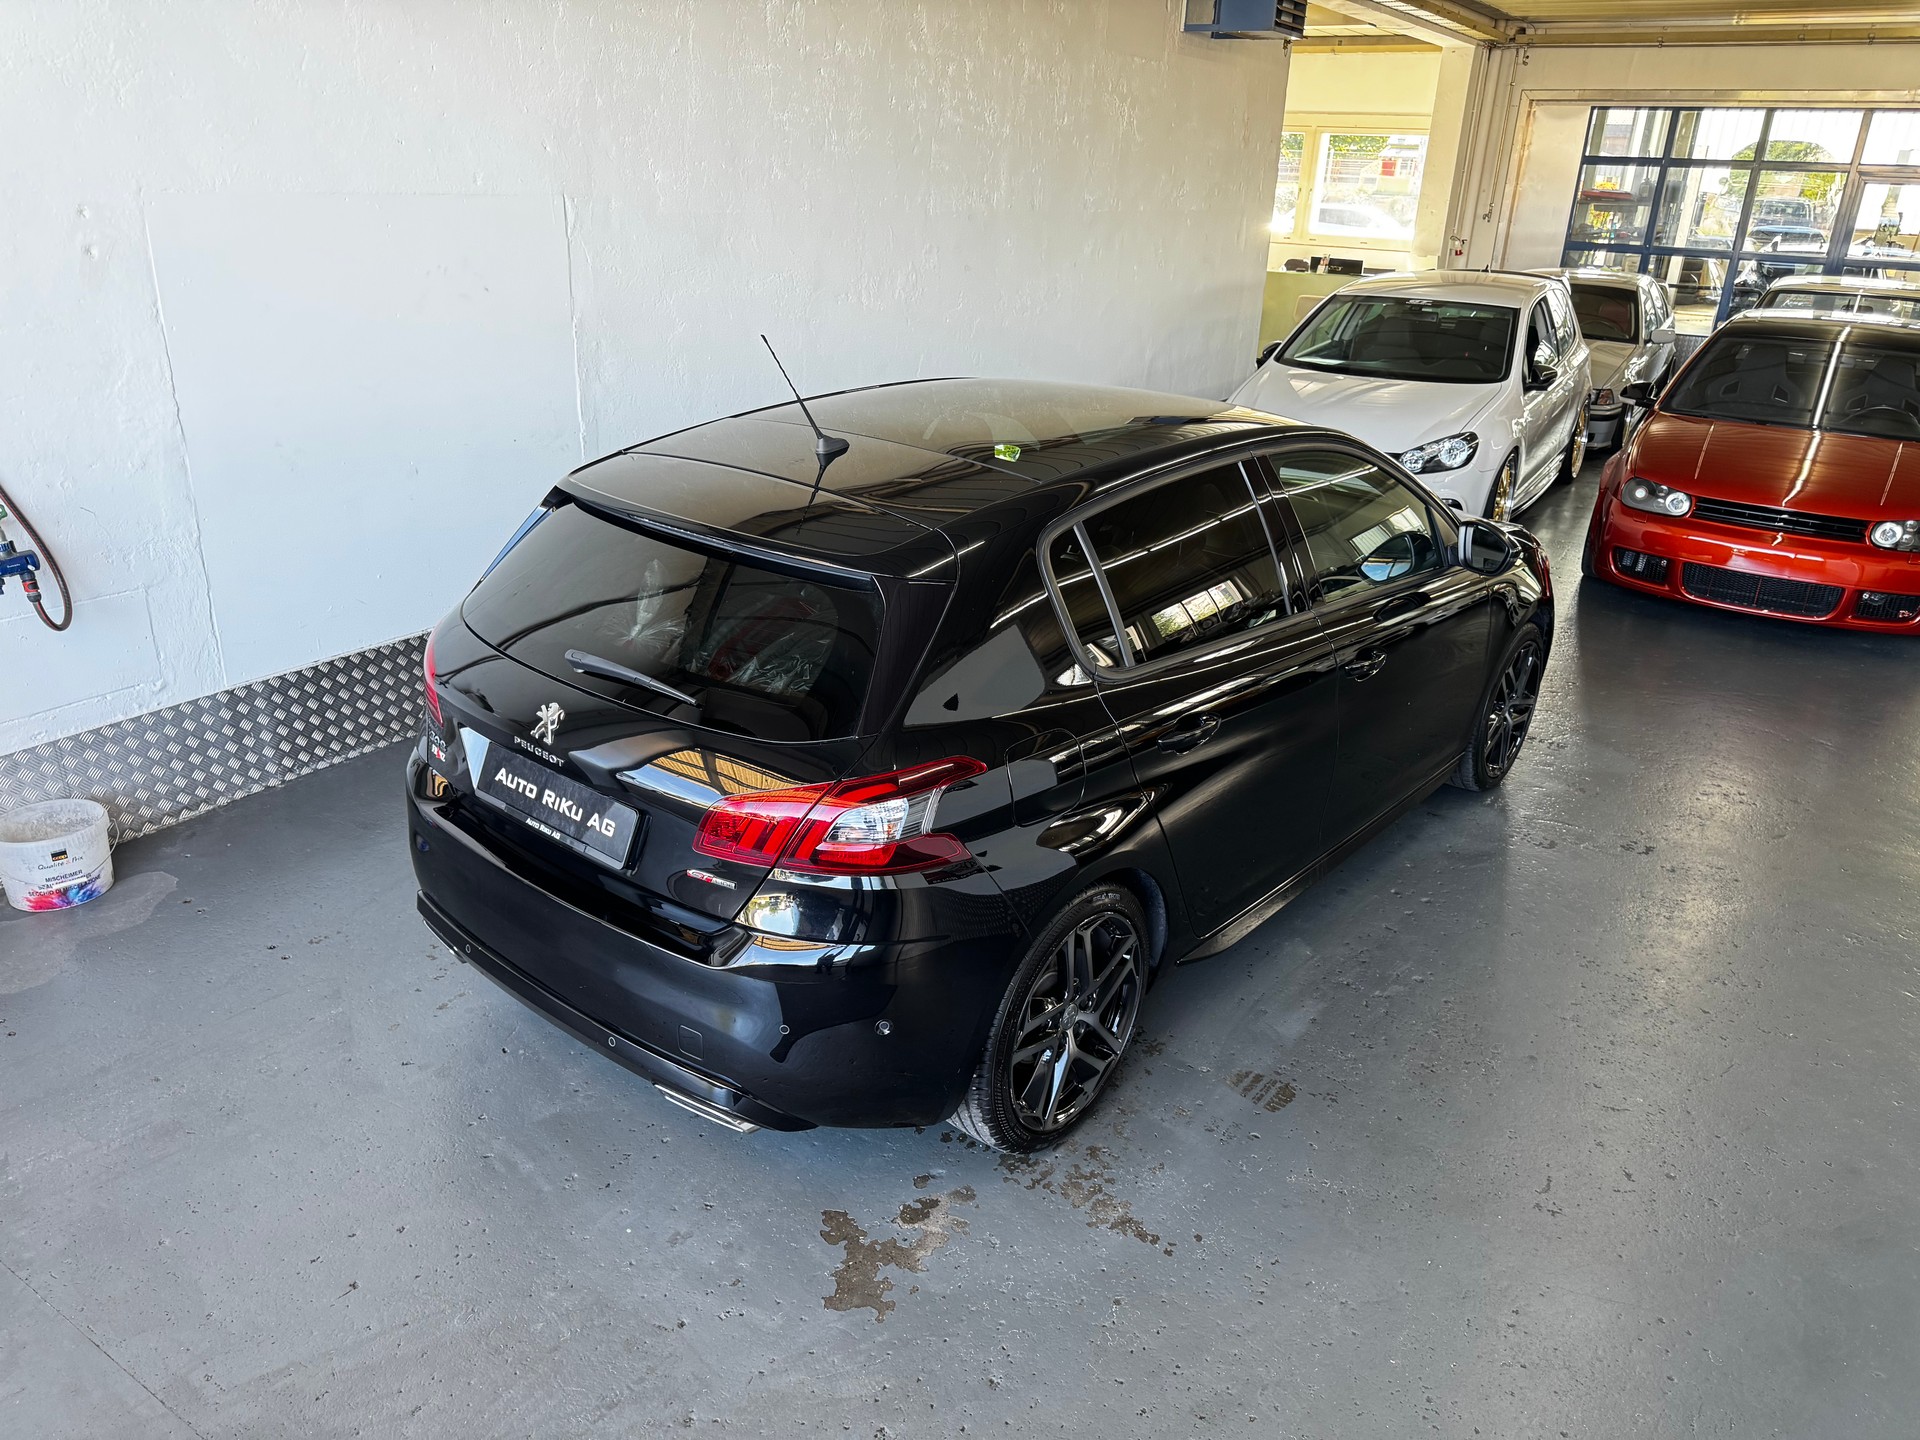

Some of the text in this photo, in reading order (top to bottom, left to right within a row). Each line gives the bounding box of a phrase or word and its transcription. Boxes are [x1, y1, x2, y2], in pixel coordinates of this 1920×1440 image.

[513, 735, 565, 767] PEUGEOT
[494, 767, 538, 799] AUTO
[586, 812, 616, 838] AG
[44, 869, 83, 883] MISCHEIMER
